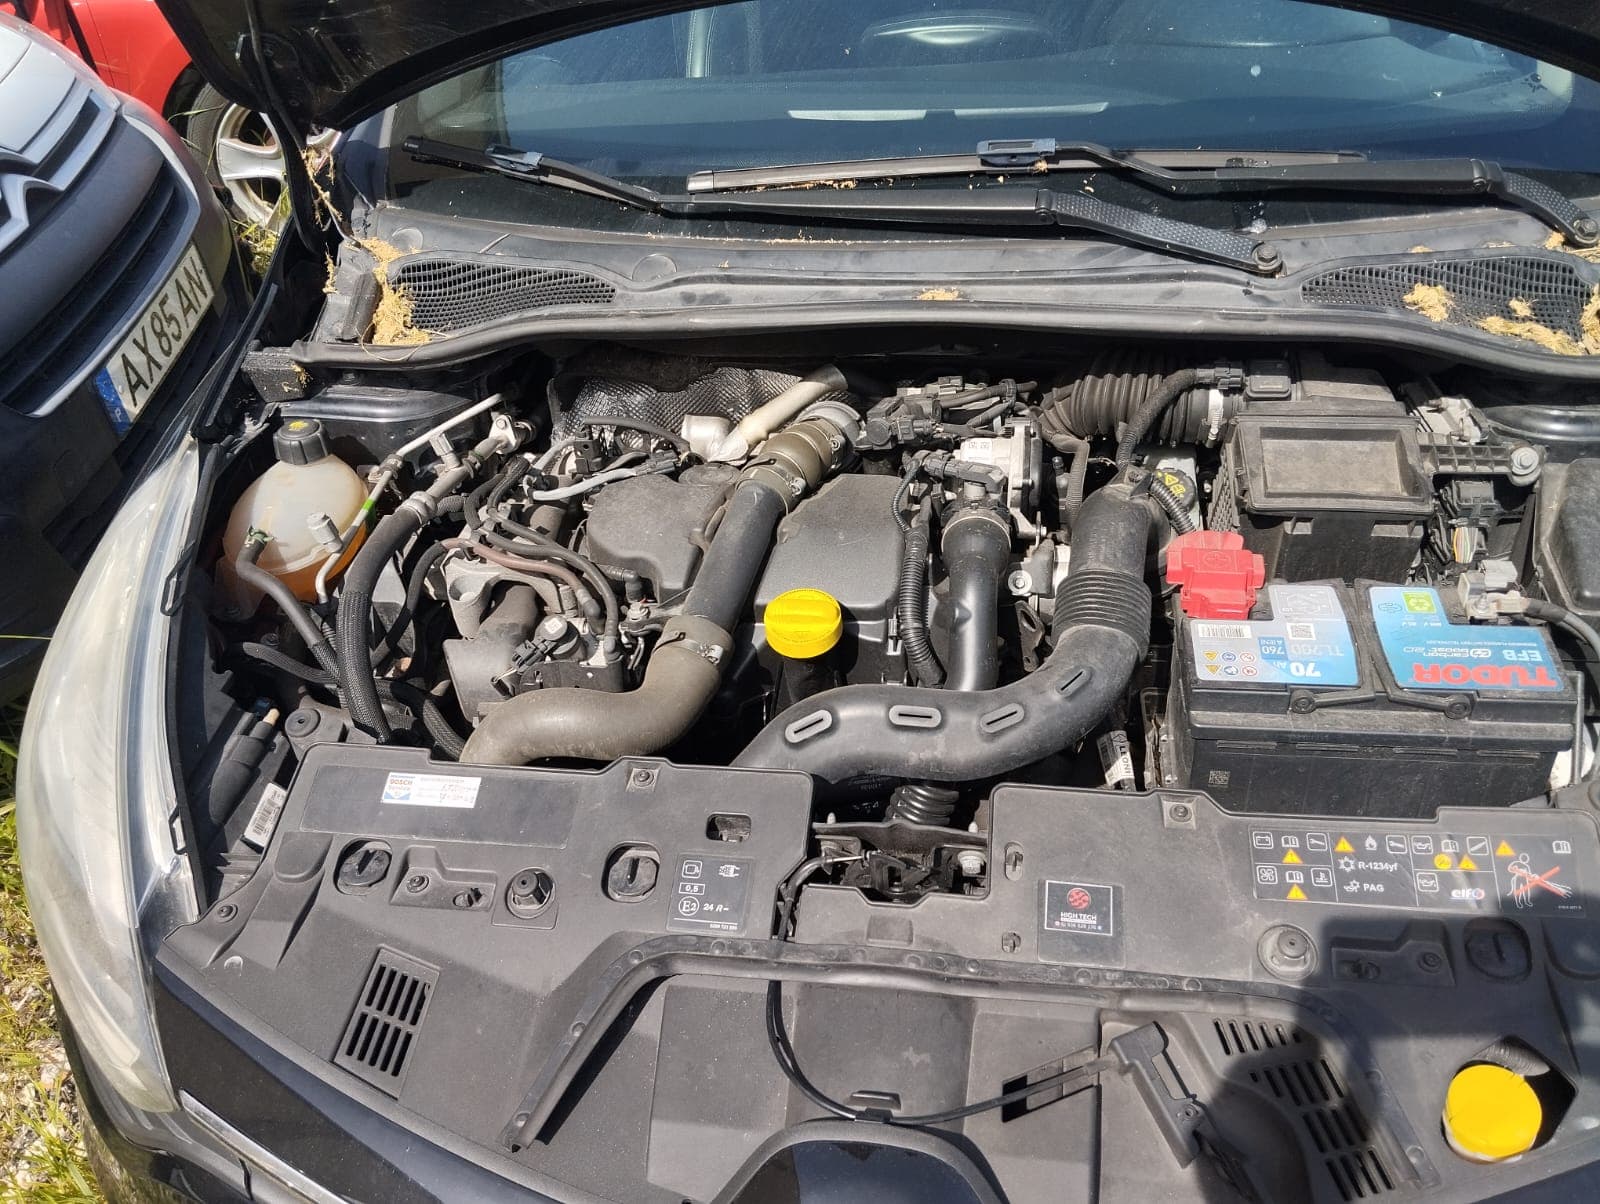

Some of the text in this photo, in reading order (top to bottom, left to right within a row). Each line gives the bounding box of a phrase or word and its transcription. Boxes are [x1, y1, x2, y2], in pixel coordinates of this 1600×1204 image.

[1261, 645, 1284, 655] 760
[1502, 649, 1543, 661] EFB
[1290, 661, 1322, 677] 70
[1412, 663, 1558, 688] TUDOR
[1358, 861, 1398, 872] R-1234yf
[1363, 883, 1385, 893] PAG
[1451, 888, 1473, 899] elf
[682, 900, 697, 912] E2
[703, 903, 714, 911] 24
